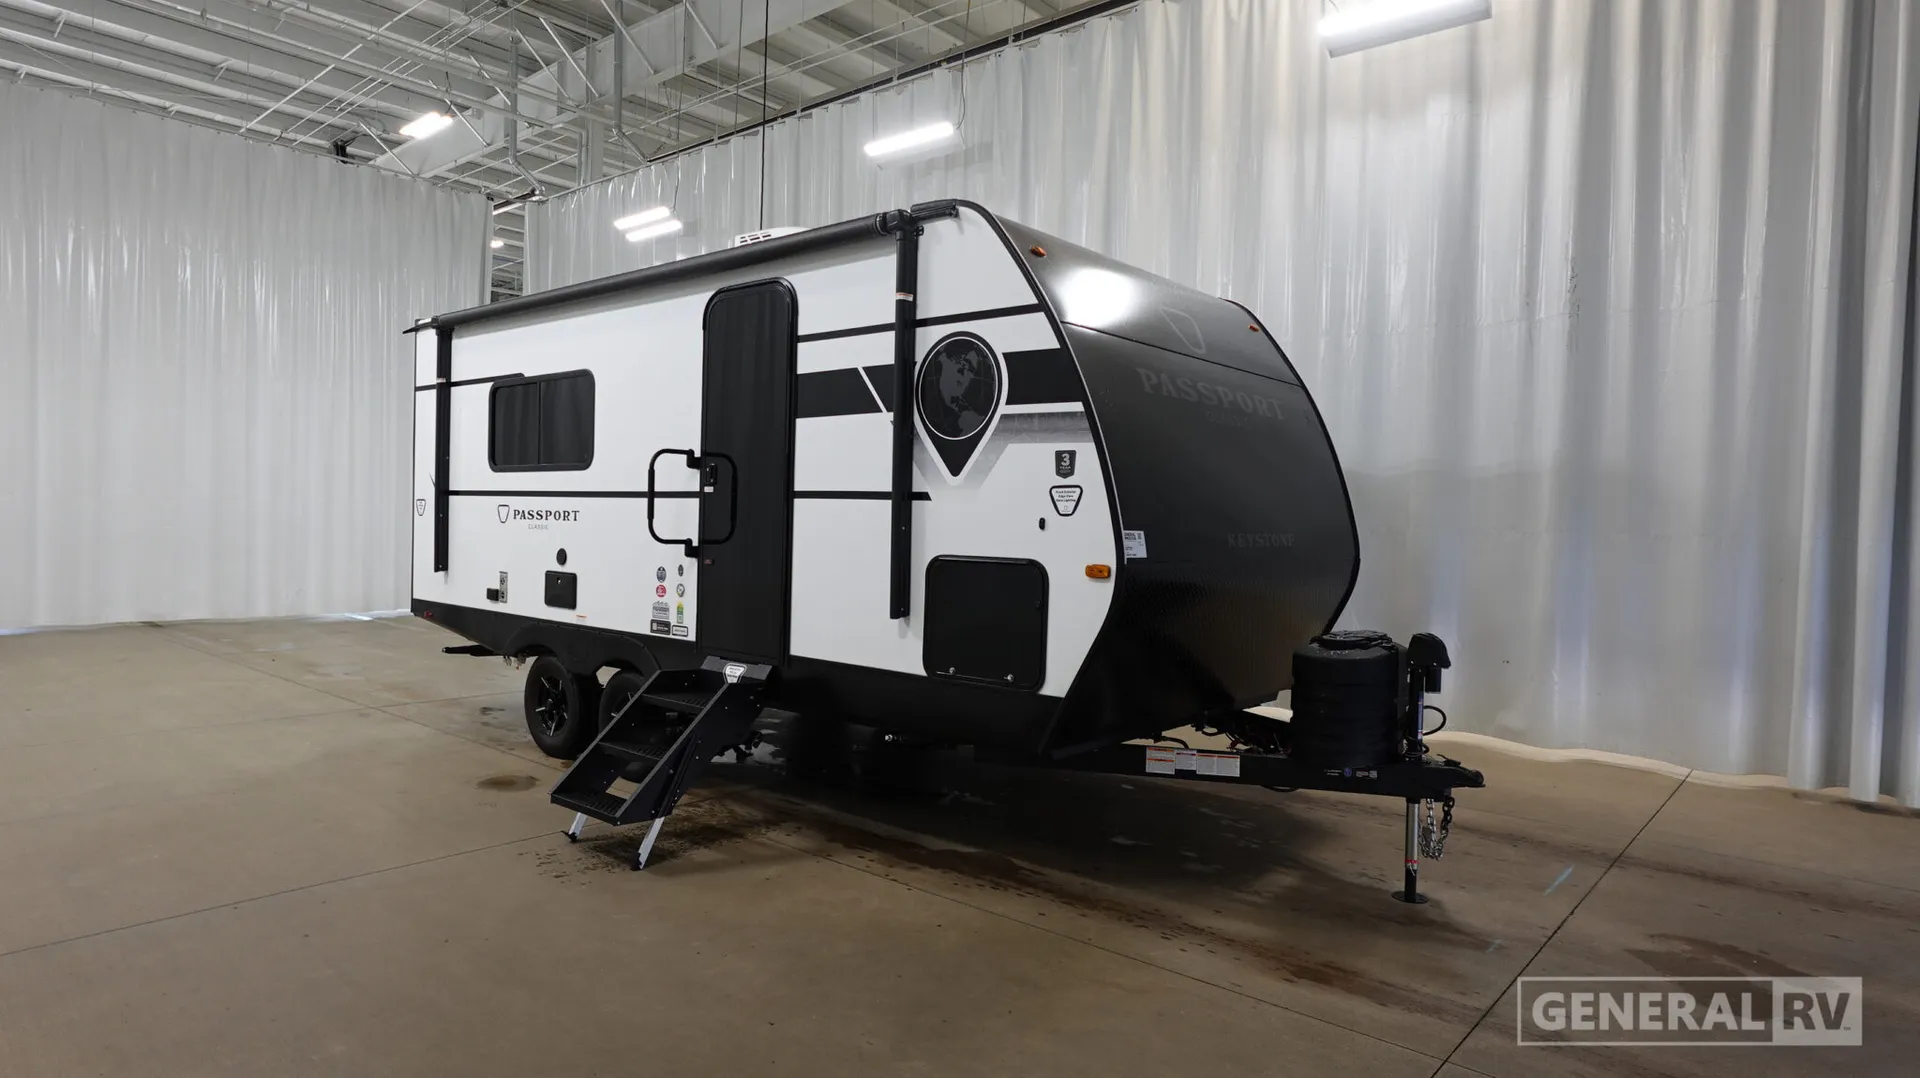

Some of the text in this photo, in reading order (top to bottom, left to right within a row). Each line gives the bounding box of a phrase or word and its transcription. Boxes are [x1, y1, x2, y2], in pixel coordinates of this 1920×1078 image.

[1135, 367, 1285, 420] PASSPORT
[1061, 453, 1070, 466] 3
[513, 509, 580, 521] PASSPORT
